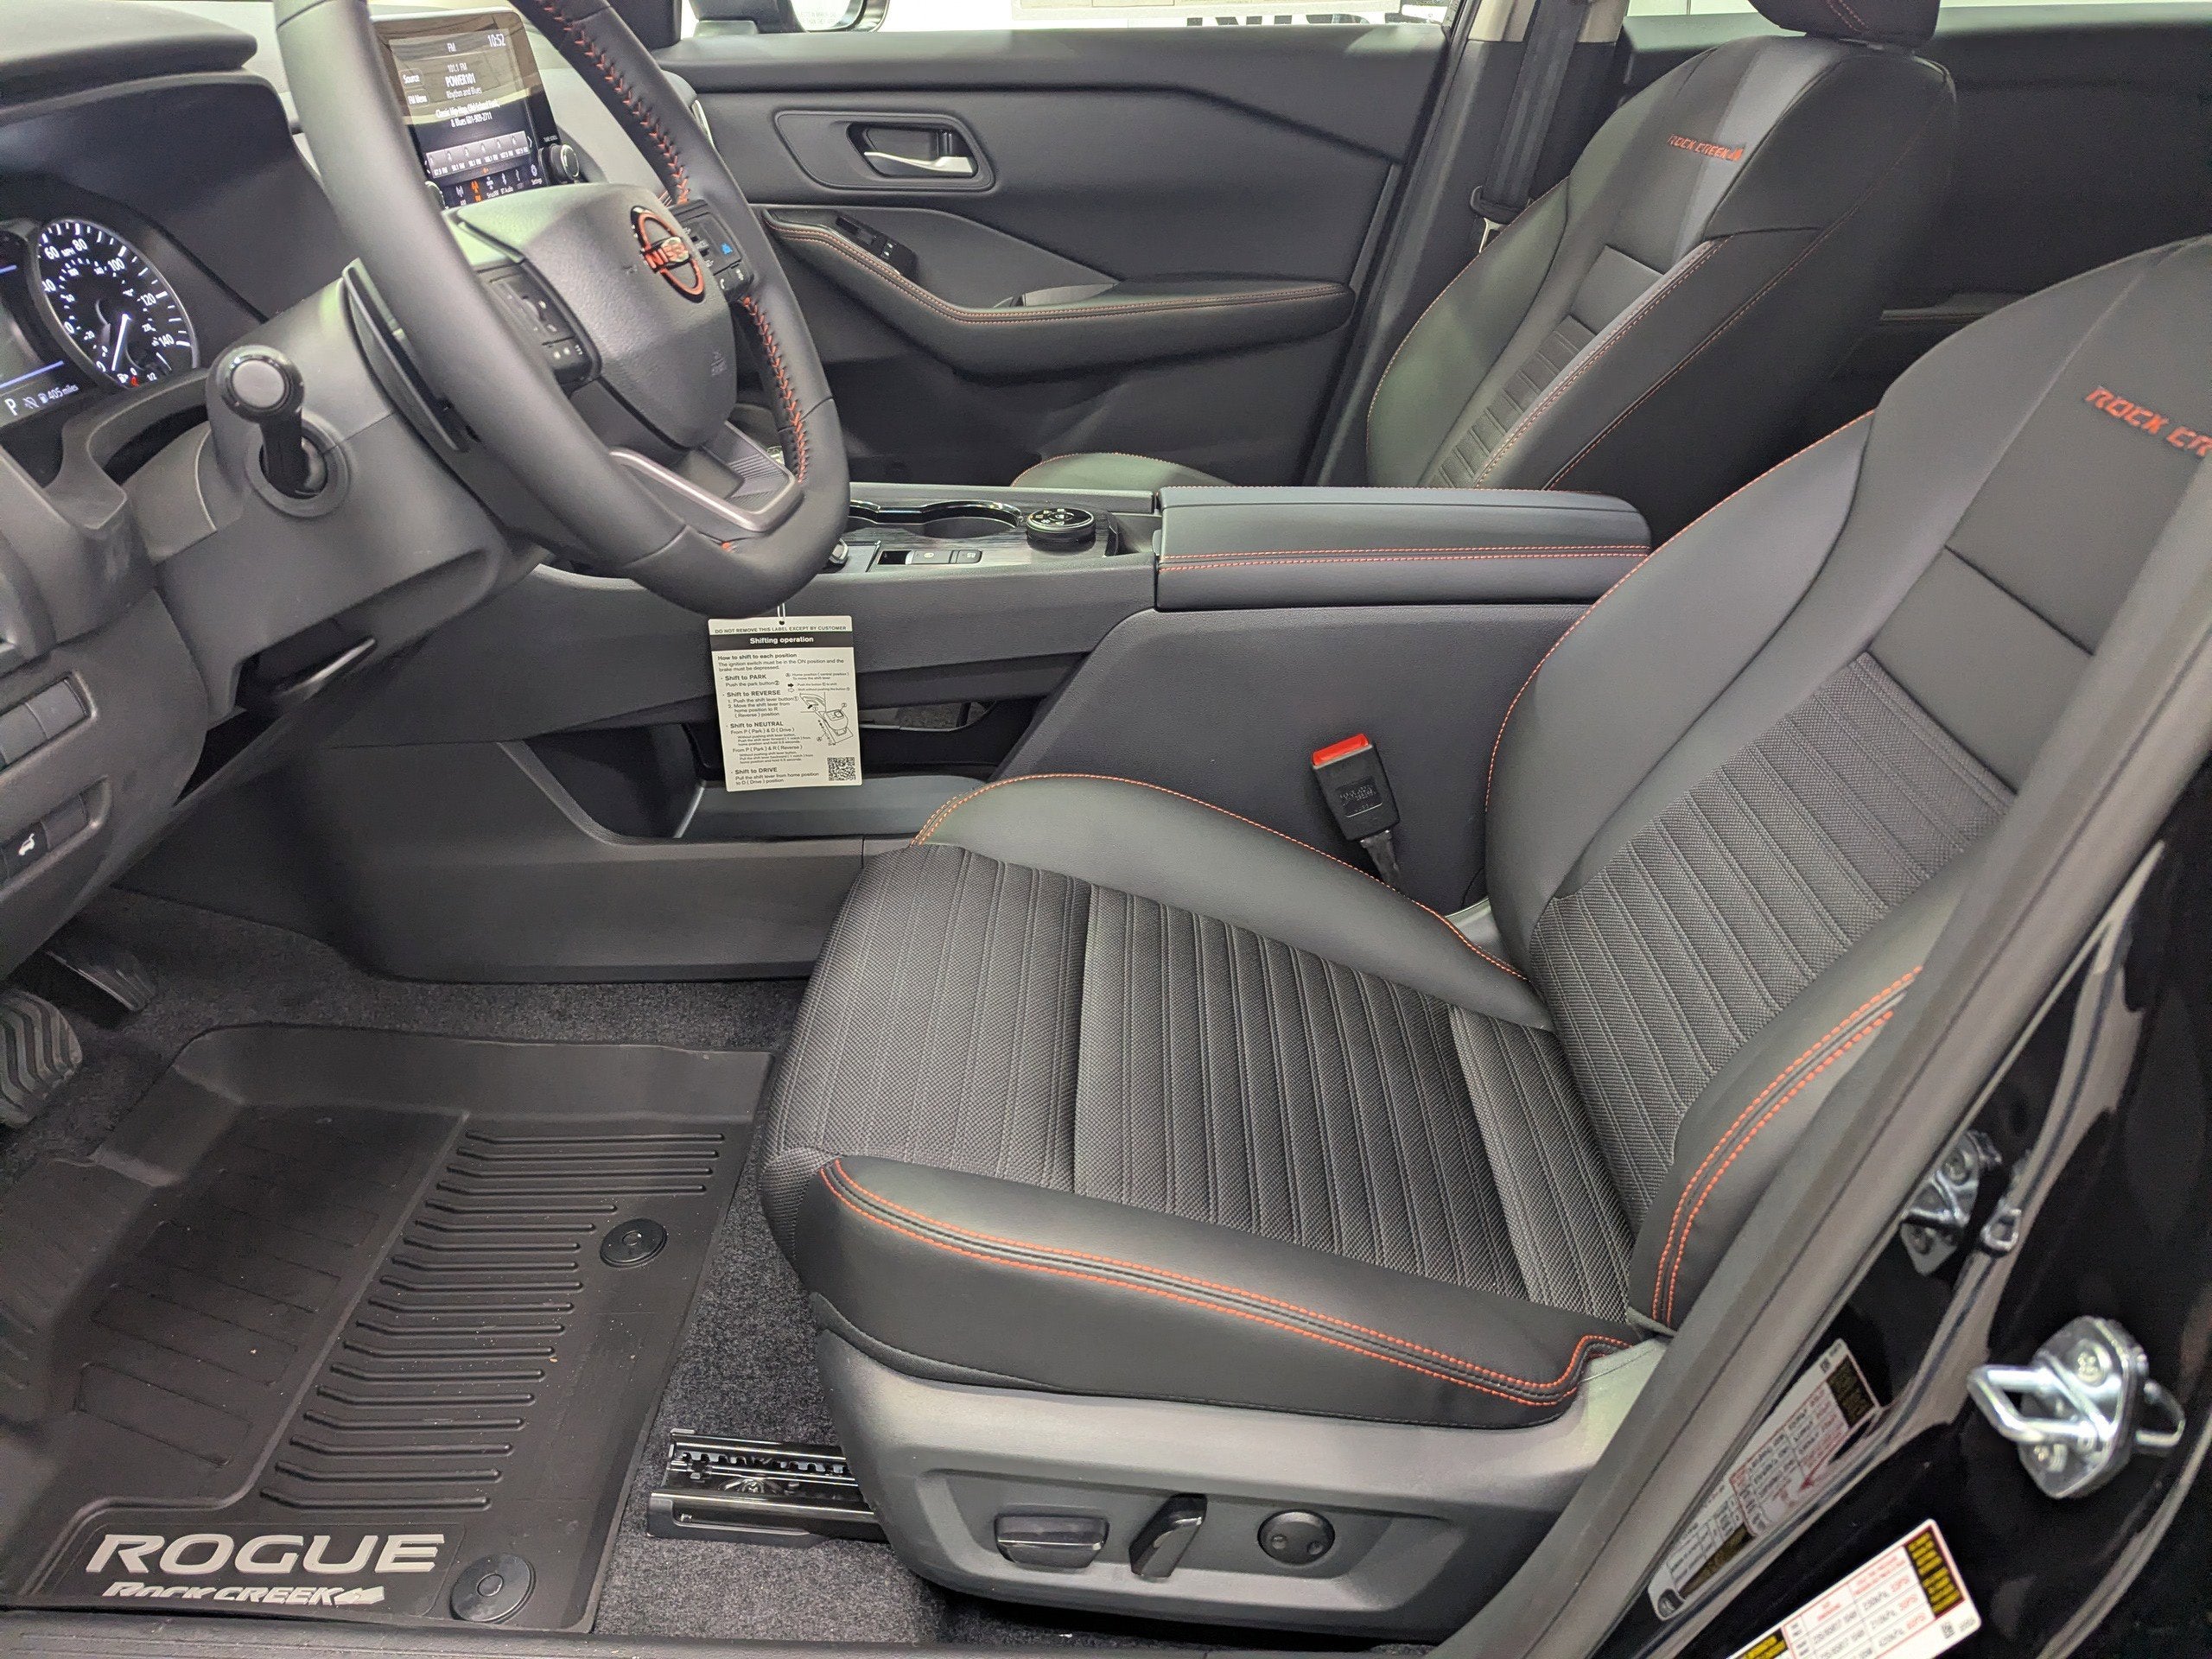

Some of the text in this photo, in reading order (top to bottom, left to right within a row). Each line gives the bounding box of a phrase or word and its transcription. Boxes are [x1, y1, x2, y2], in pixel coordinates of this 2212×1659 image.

[447, 42, 457, 52] FM
[487, 34, 505, 48] 10:52
[402, 74, 420, 84] Source
[445, 73, 476, 87] POWER101
[1667, 134, 1731, 159] ROCK CREEK
[44, 245, 60, 260] 60
[72, 238, 88, 251] 80
[107, 257, 125, 271] 100
[41, 278, 57, 292] 40
[140, 293, 156, 307] 120
[64, 321, 75, 334] 0
[158, 334, 175, 347] 140
[48, 384, 79, 400] 405 miles
[4, 398, 18, 416] P
[2084, 386, 2170, 435] ROCK
[86, 1534, 444, 1574] ROGUE
[214, 1586, 346, 1606] CREEK
